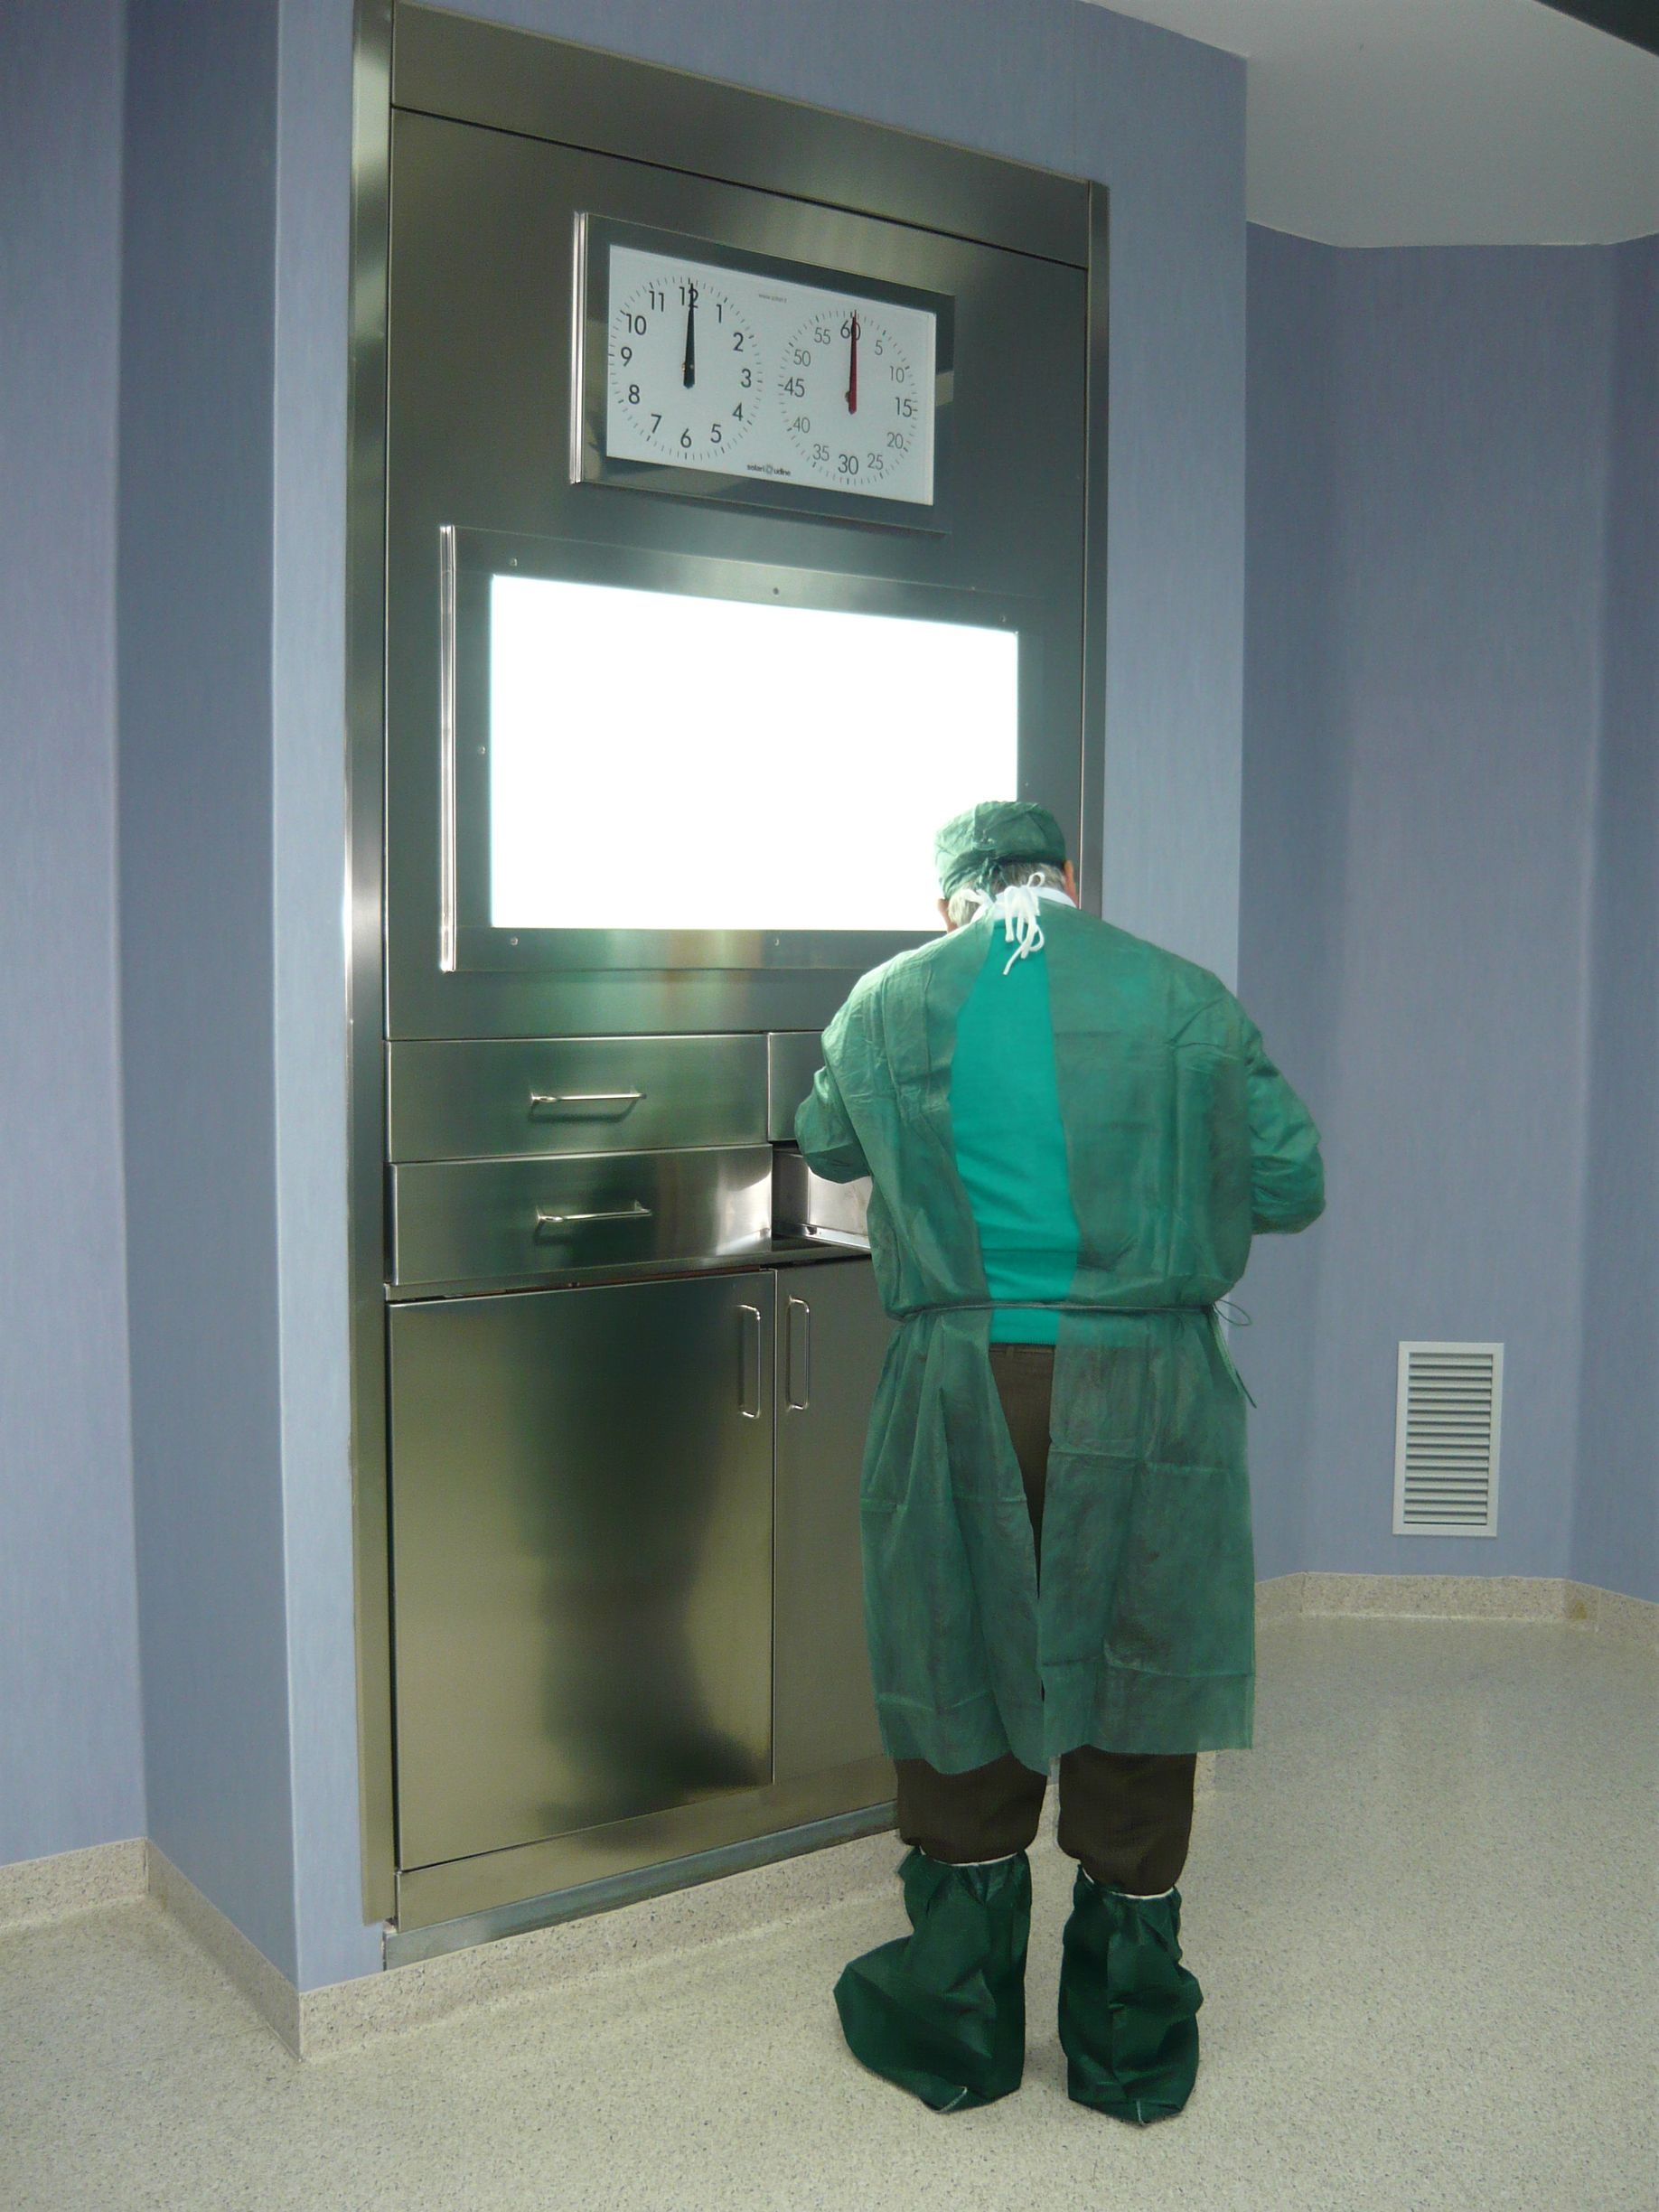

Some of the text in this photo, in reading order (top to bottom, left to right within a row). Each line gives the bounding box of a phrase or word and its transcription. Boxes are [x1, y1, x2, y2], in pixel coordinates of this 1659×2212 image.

[649, 291, 664, 312] 11
[680, 286, 698, 308] 12
[717, 305, 722, 323] 1
[625, 314, 647, 335] 10
[840, 321, 861, 341] 60
[733, 333, 744, 351] 2
[814, 327, 831, 344] 55
[621, 347, 633, 367] 9
[875, 341, 883, 355] 5
[794, 350, 811, 367] 50
[741, 369, 752, 388] 3
[890, 366, 904, 383] 10
[629, 385, 640, 405] 8
[783, 377, 805, 398] 45
[733, 403, 743, 421] 4
[895, 398, 912, 417] 15
[651, 414, 662, 434] 7
[792, 417, 811, 433] 40
[680, 428, 692, 448] 6
[710, 424, 722, 444] 5
[886, 432, 904, 449] 20
[812, 444, 830, 462] 35
[867, 454, 884, 470] 25
[838, 455, 858, 474] 30
